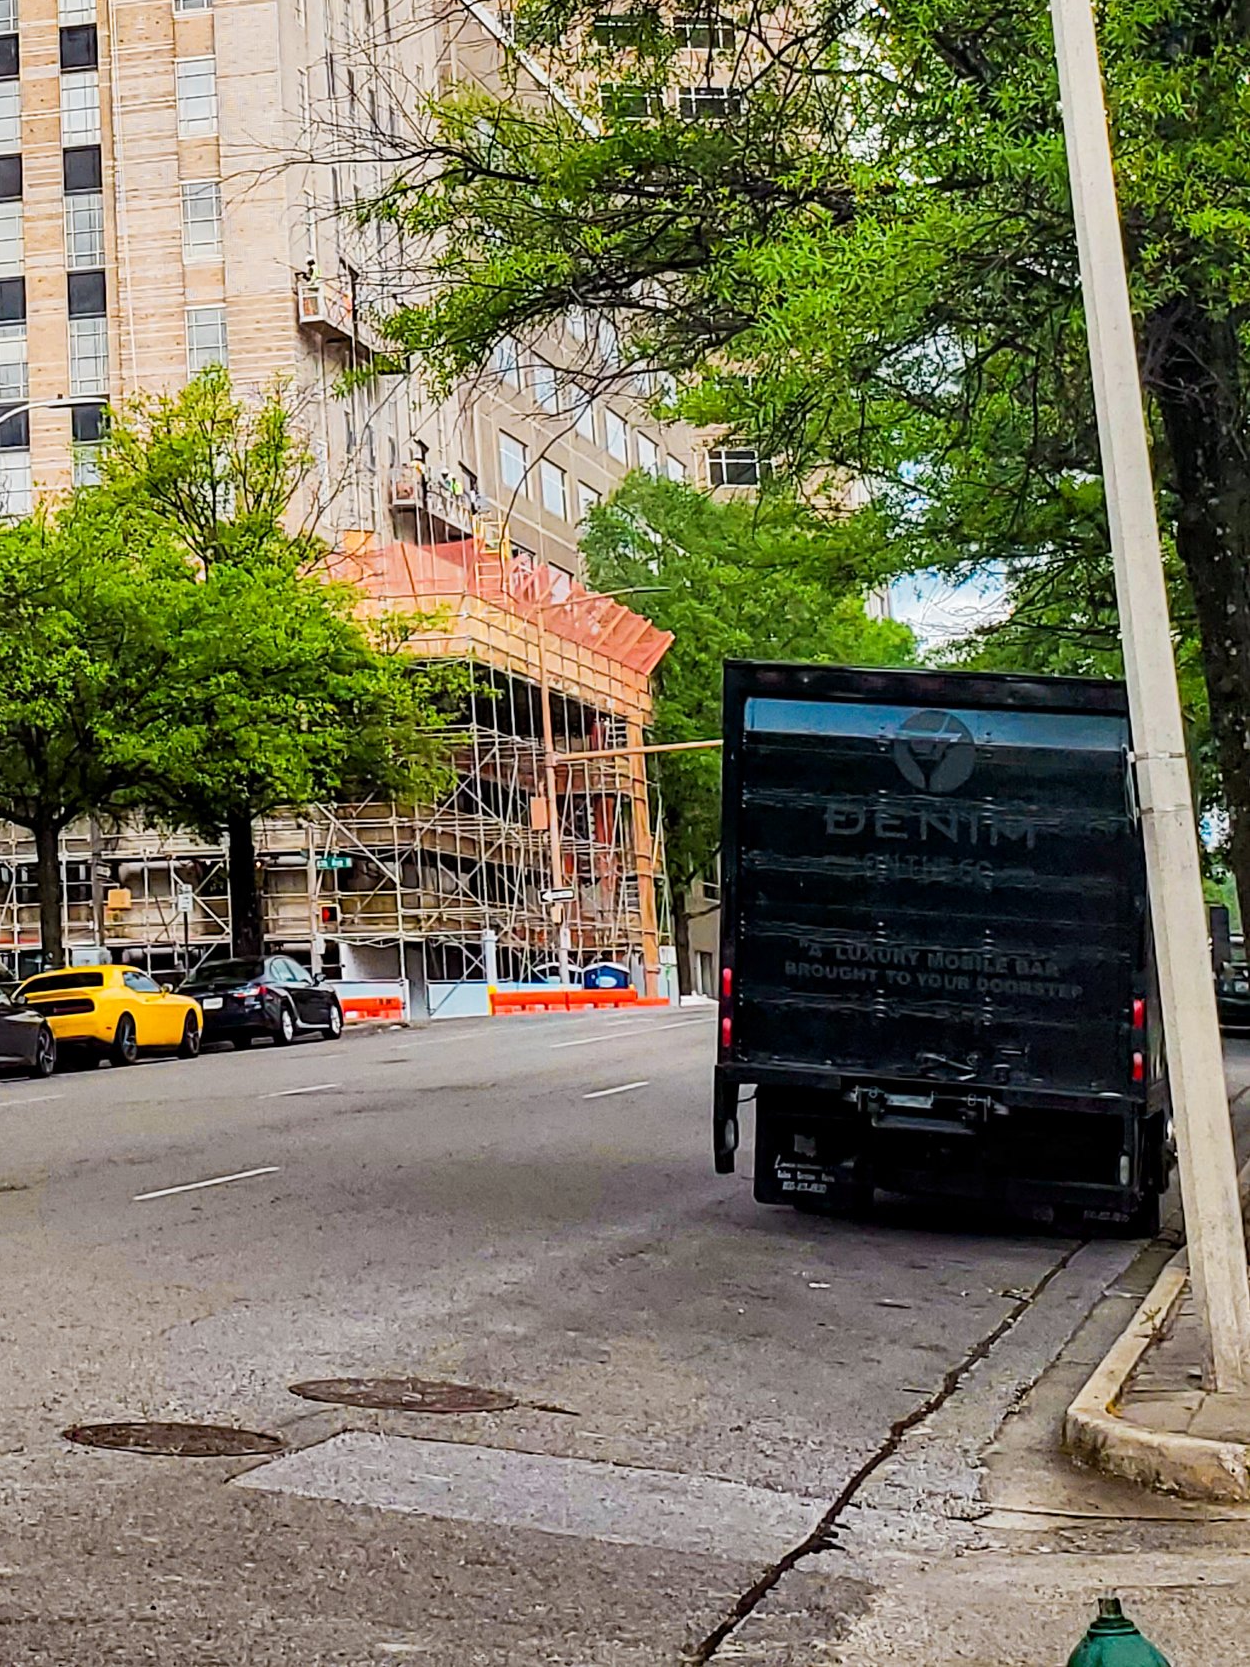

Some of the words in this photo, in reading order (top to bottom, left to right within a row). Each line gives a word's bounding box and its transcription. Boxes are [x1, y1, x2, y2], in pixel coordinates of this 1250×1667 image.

[825, 803, 1037, 849] DENIM
[835, 944, 921, 967] LUXURY
[927, 951, 1009, 974] MOBILE
[784, 960, 878, 982] BROUGHT
[885, 970, 911, 986] TO
[916, 972, 971, 991] YOUR
[976, 977, 1084, 999] DOORSTEP
